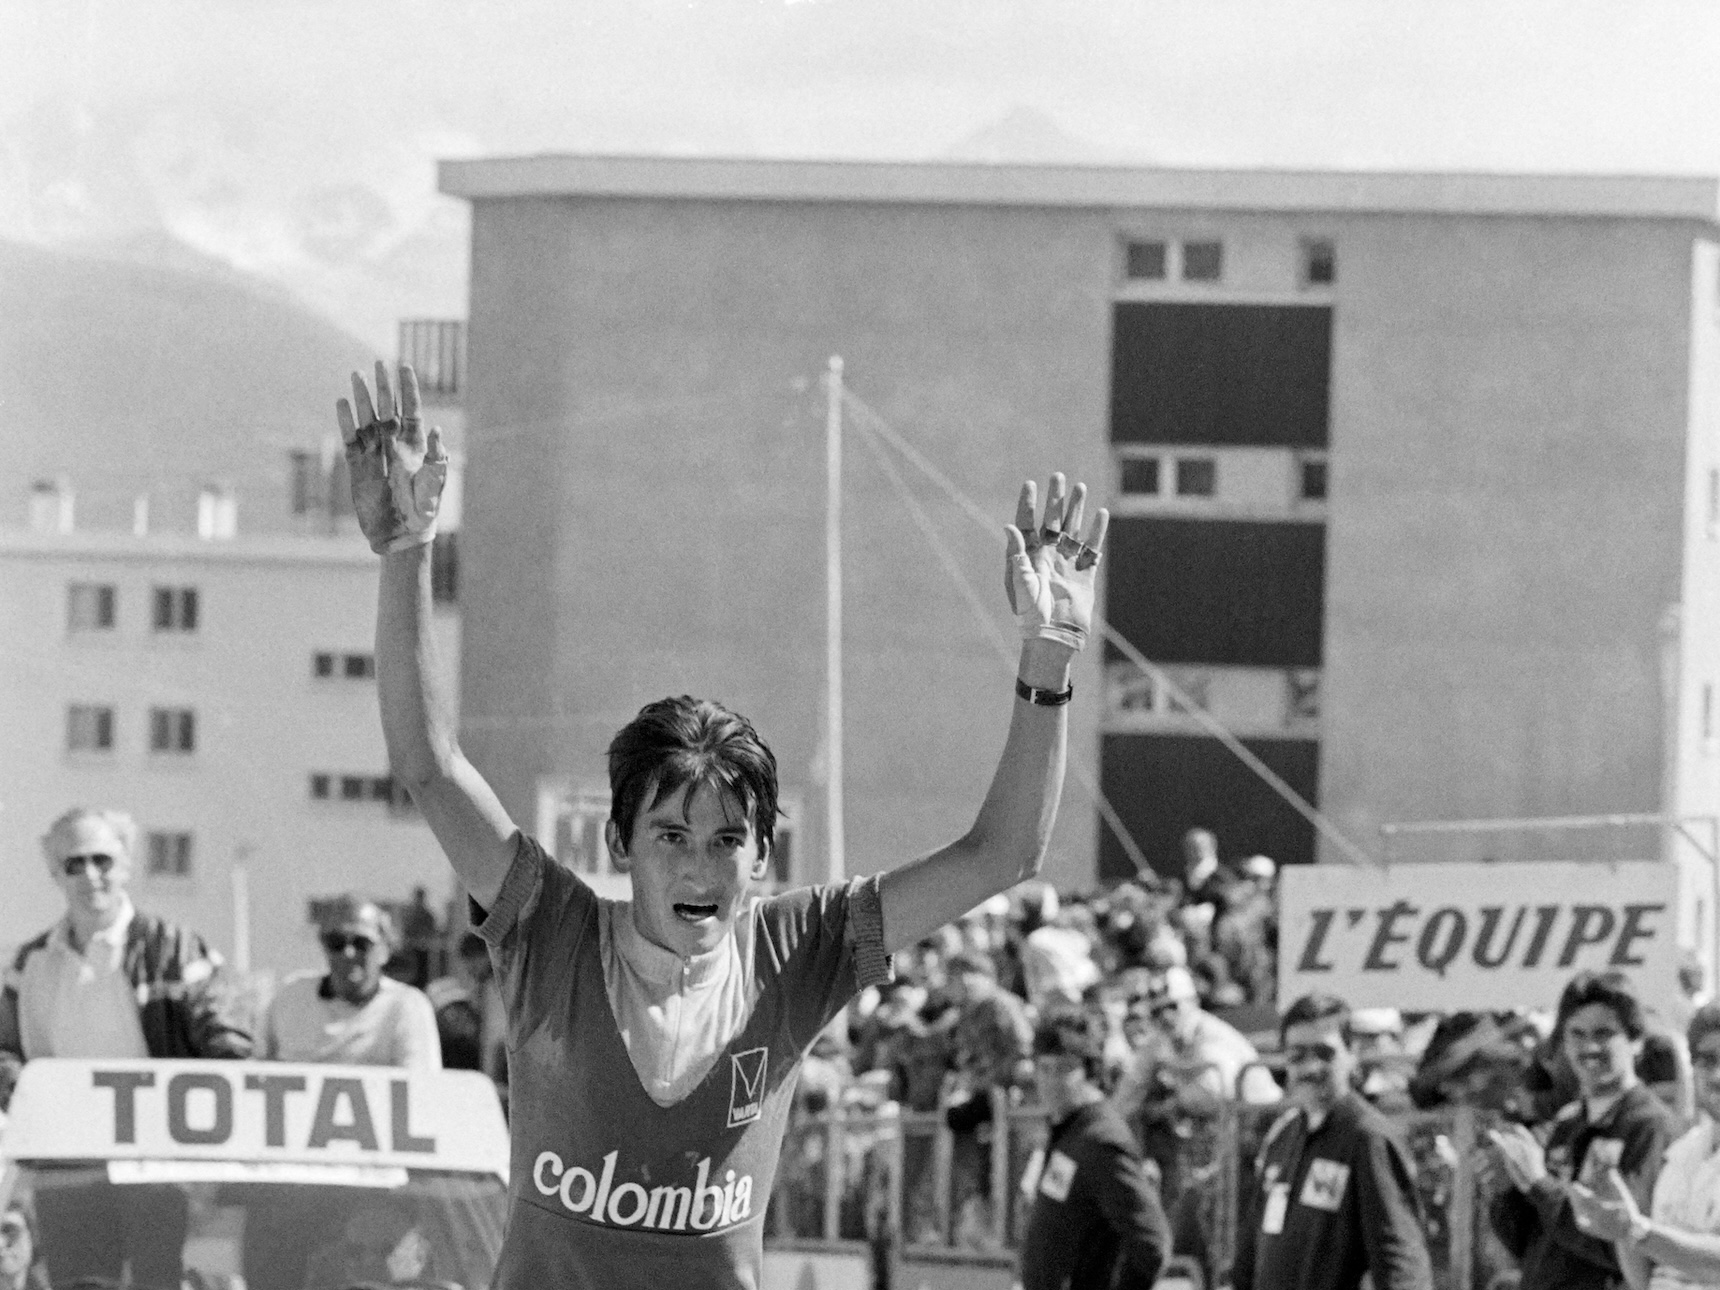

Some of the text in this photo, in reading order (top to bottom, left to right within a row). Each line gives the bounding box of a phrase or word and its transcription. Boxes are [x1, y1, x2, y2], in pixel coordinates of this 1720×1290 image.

[1296, 900, 1666, 979] L'ÉQUIPE
[92, 1070, 437, 1154] TOTAL
[532, 1149, 754, 1231] colombia
